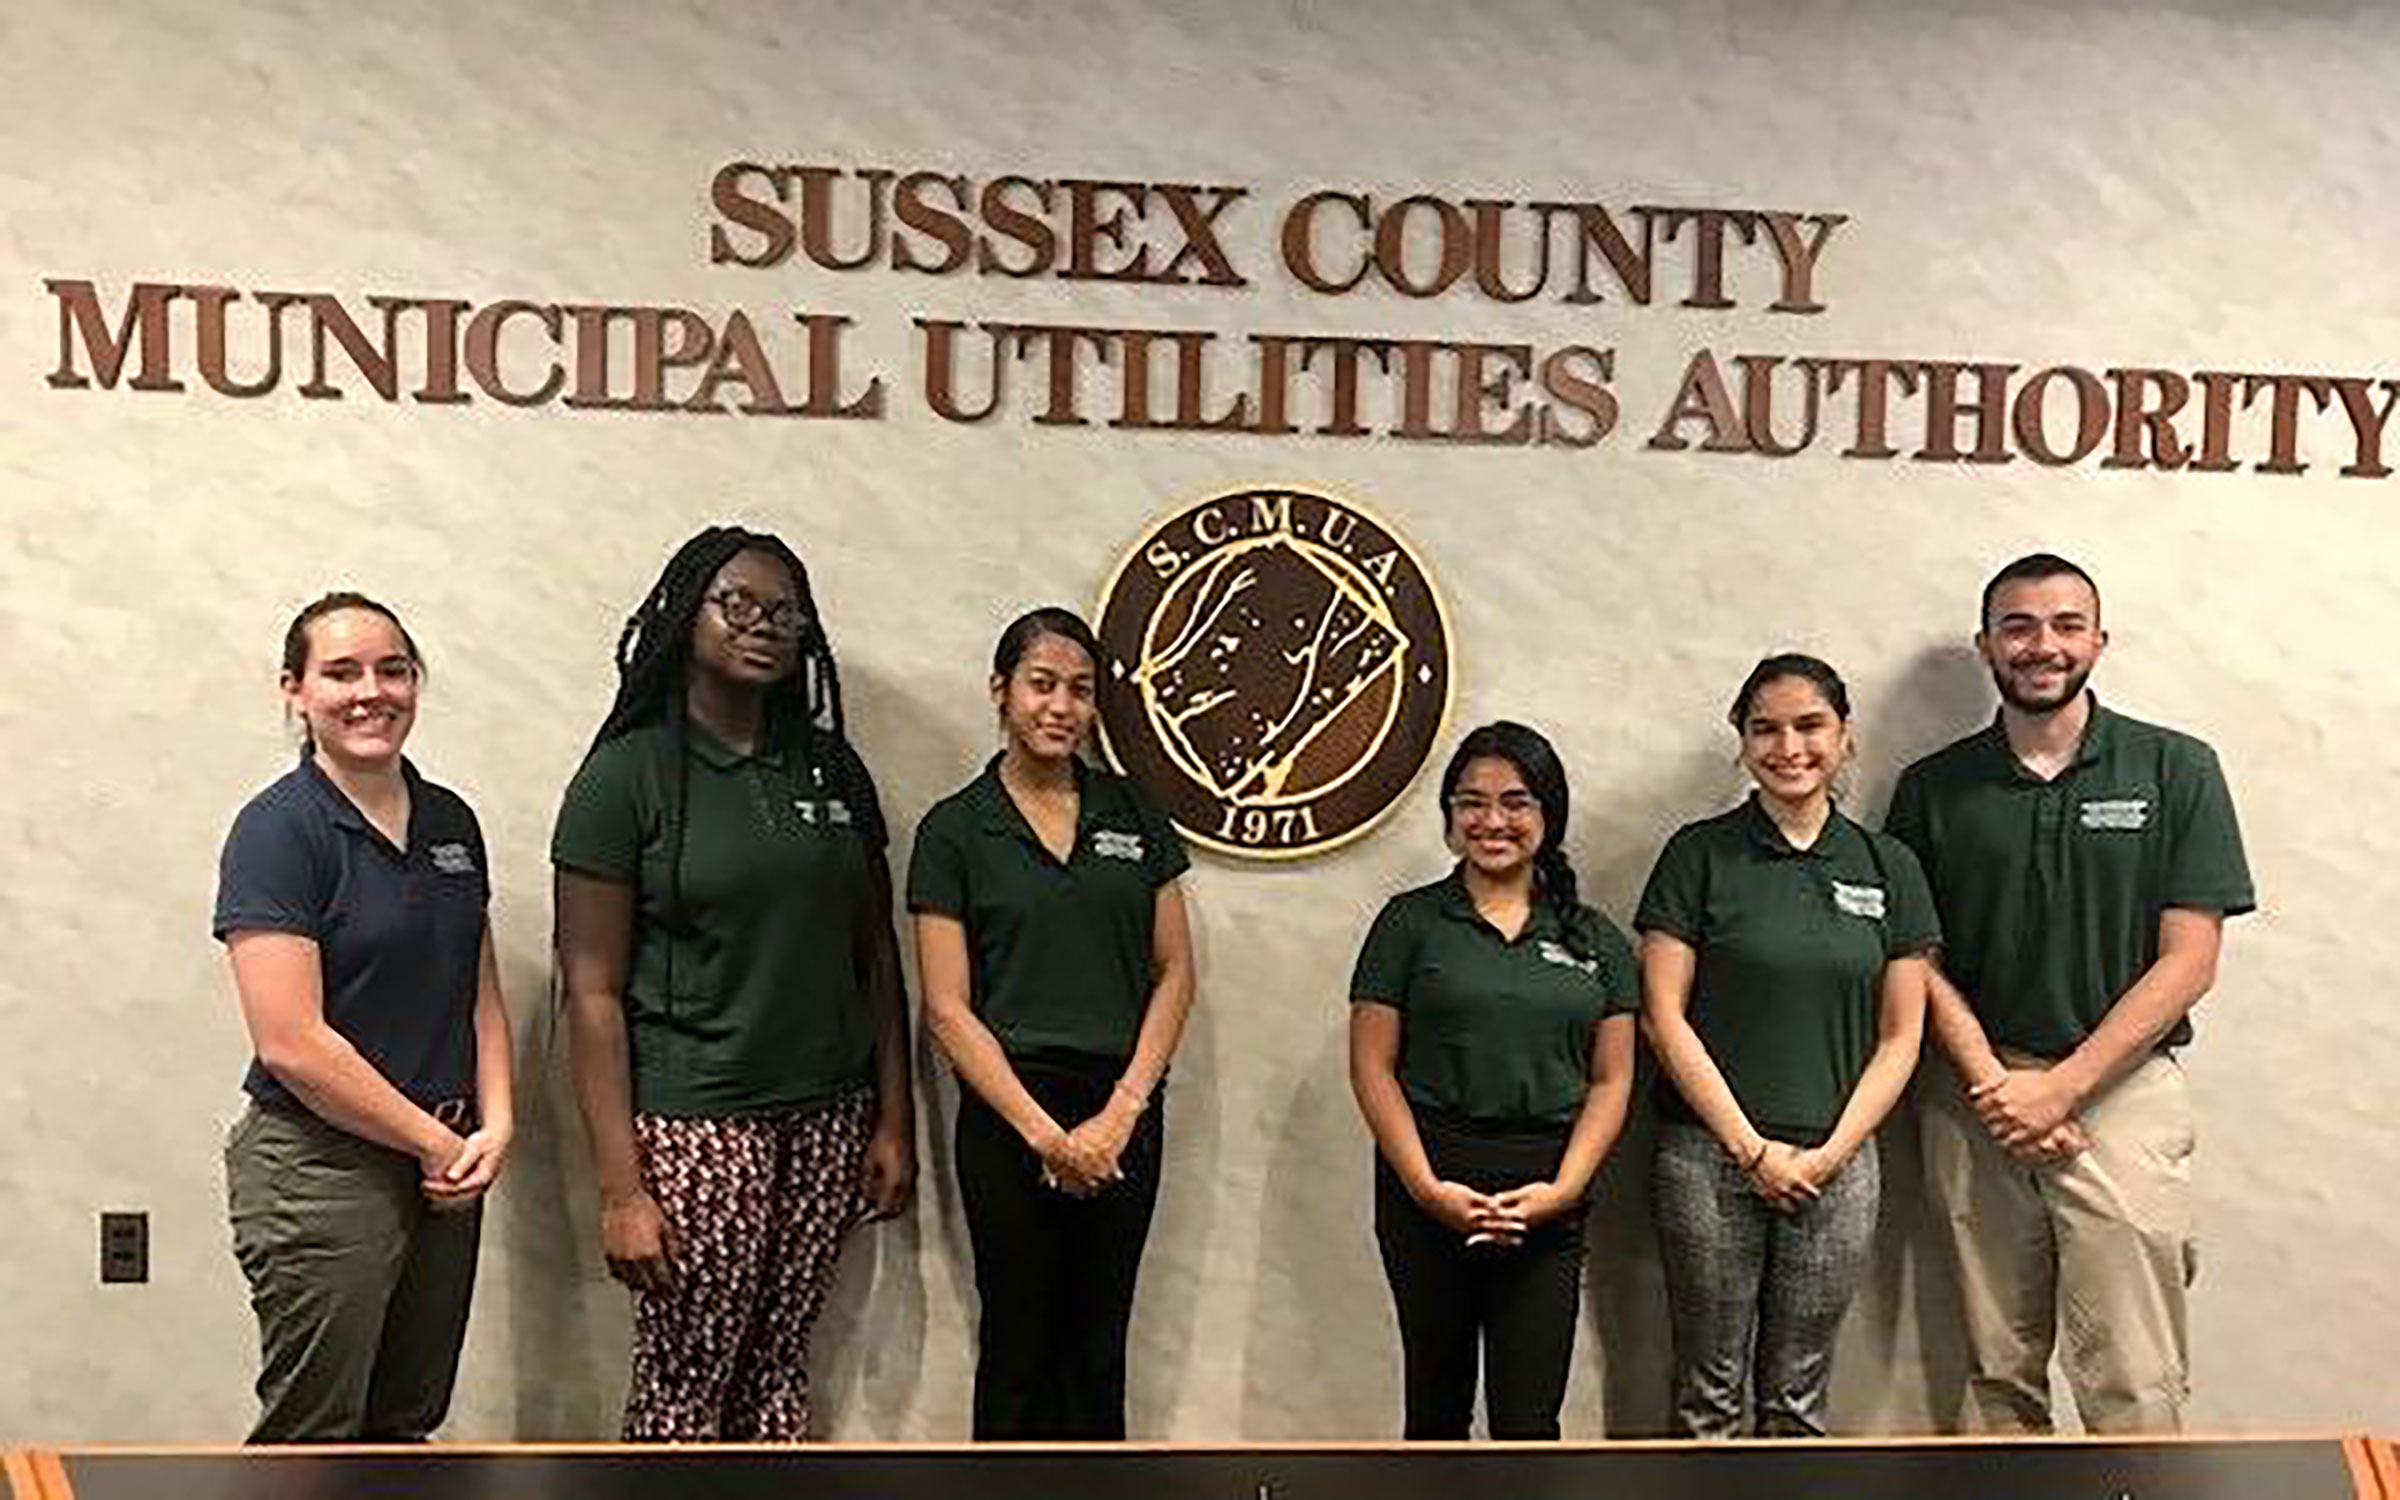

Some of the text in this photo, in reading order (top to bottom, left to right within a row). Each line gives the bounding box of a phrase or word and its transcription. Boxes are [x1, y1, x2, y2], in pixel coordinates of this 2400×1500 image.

[711, 160, 1848, 314] SUSSEX COUNTY
[43, 278, 2400, 479] MUNICIPAL UTILITIES AUTHORITY
[1218, 806, 1320, 842] 1971
